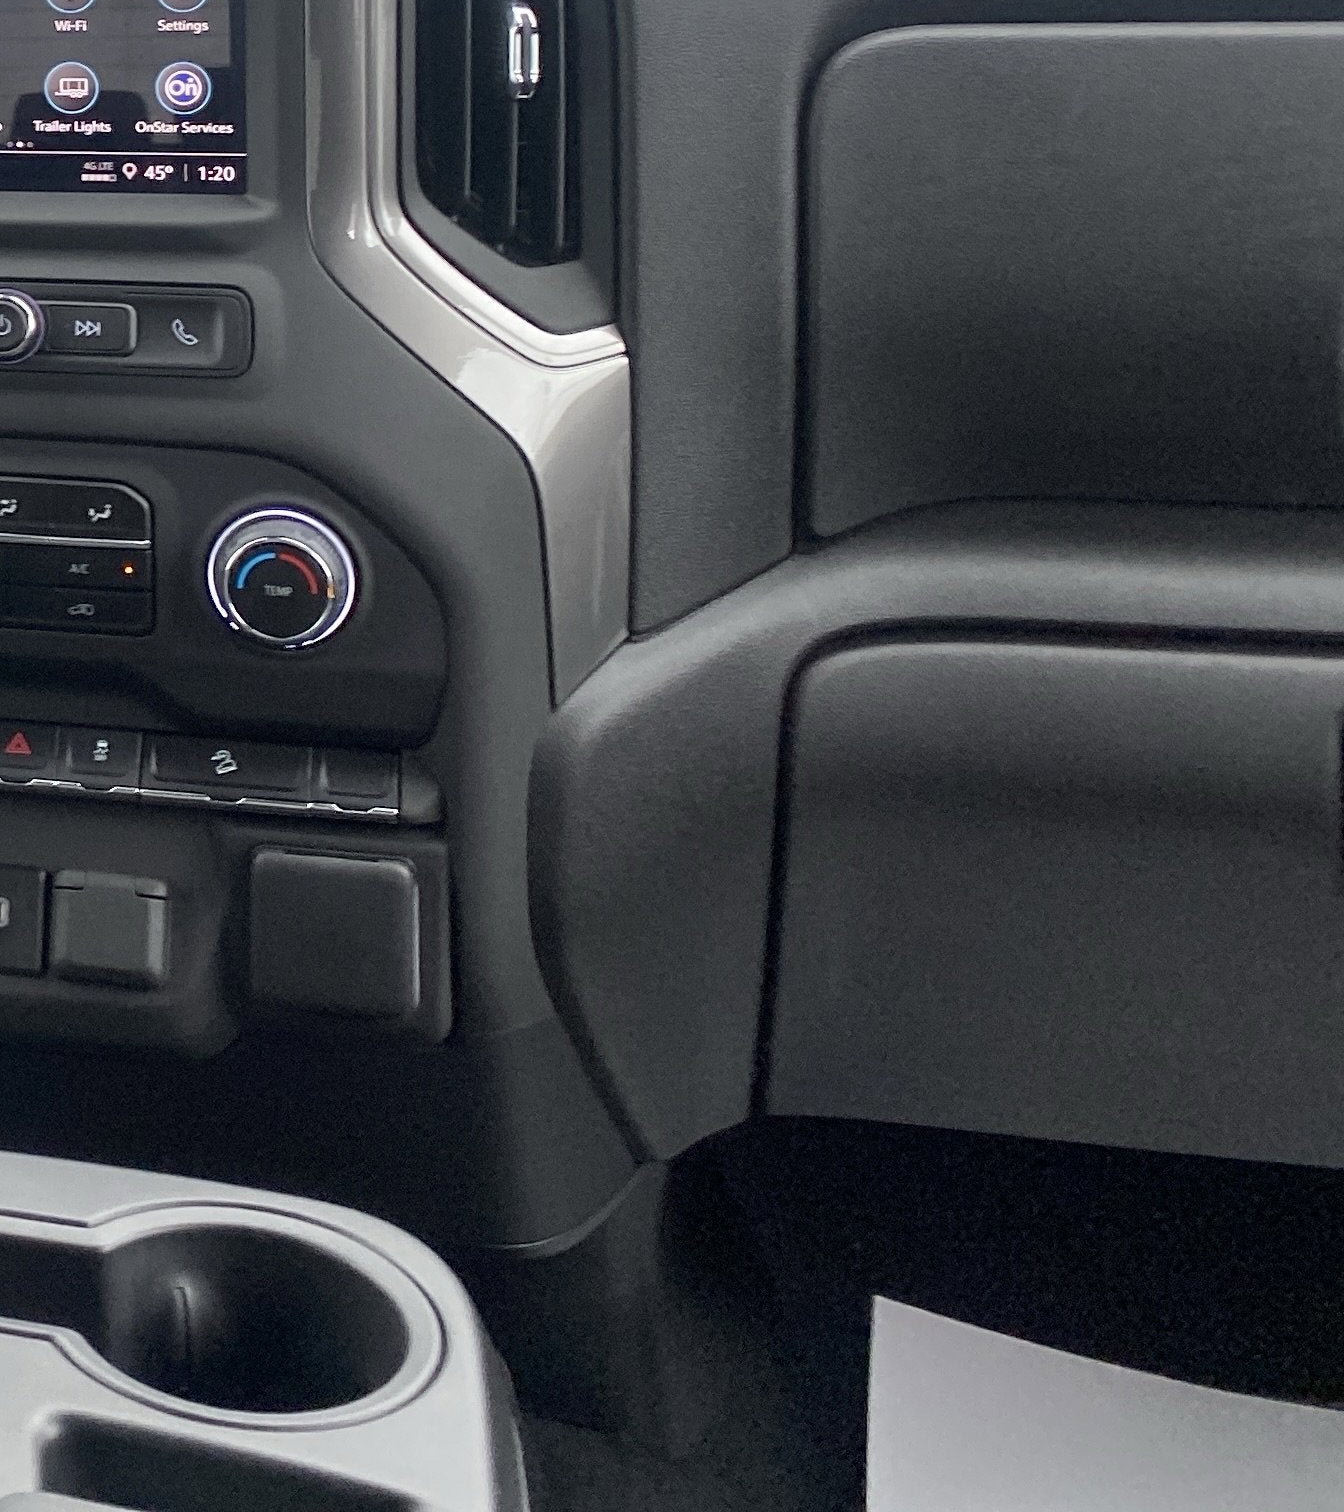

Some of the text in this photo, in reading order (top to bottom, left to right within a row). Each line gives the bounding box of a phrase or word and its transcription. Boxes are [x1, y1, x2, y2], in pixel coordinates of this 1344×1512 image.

[54, 19, 88, 32] Wi-Fi
[157, 19, 210, 35] Settings
[168, 77, 198, 97] On
[32, 120, 112, 136] Trailer Lights
[134, 121, 234, 134] OnStar Services
[143, 165, 174, 181] 45°
[197, 166, 236, 182] 1:20
[263, 583, 295, 597] TEMP
